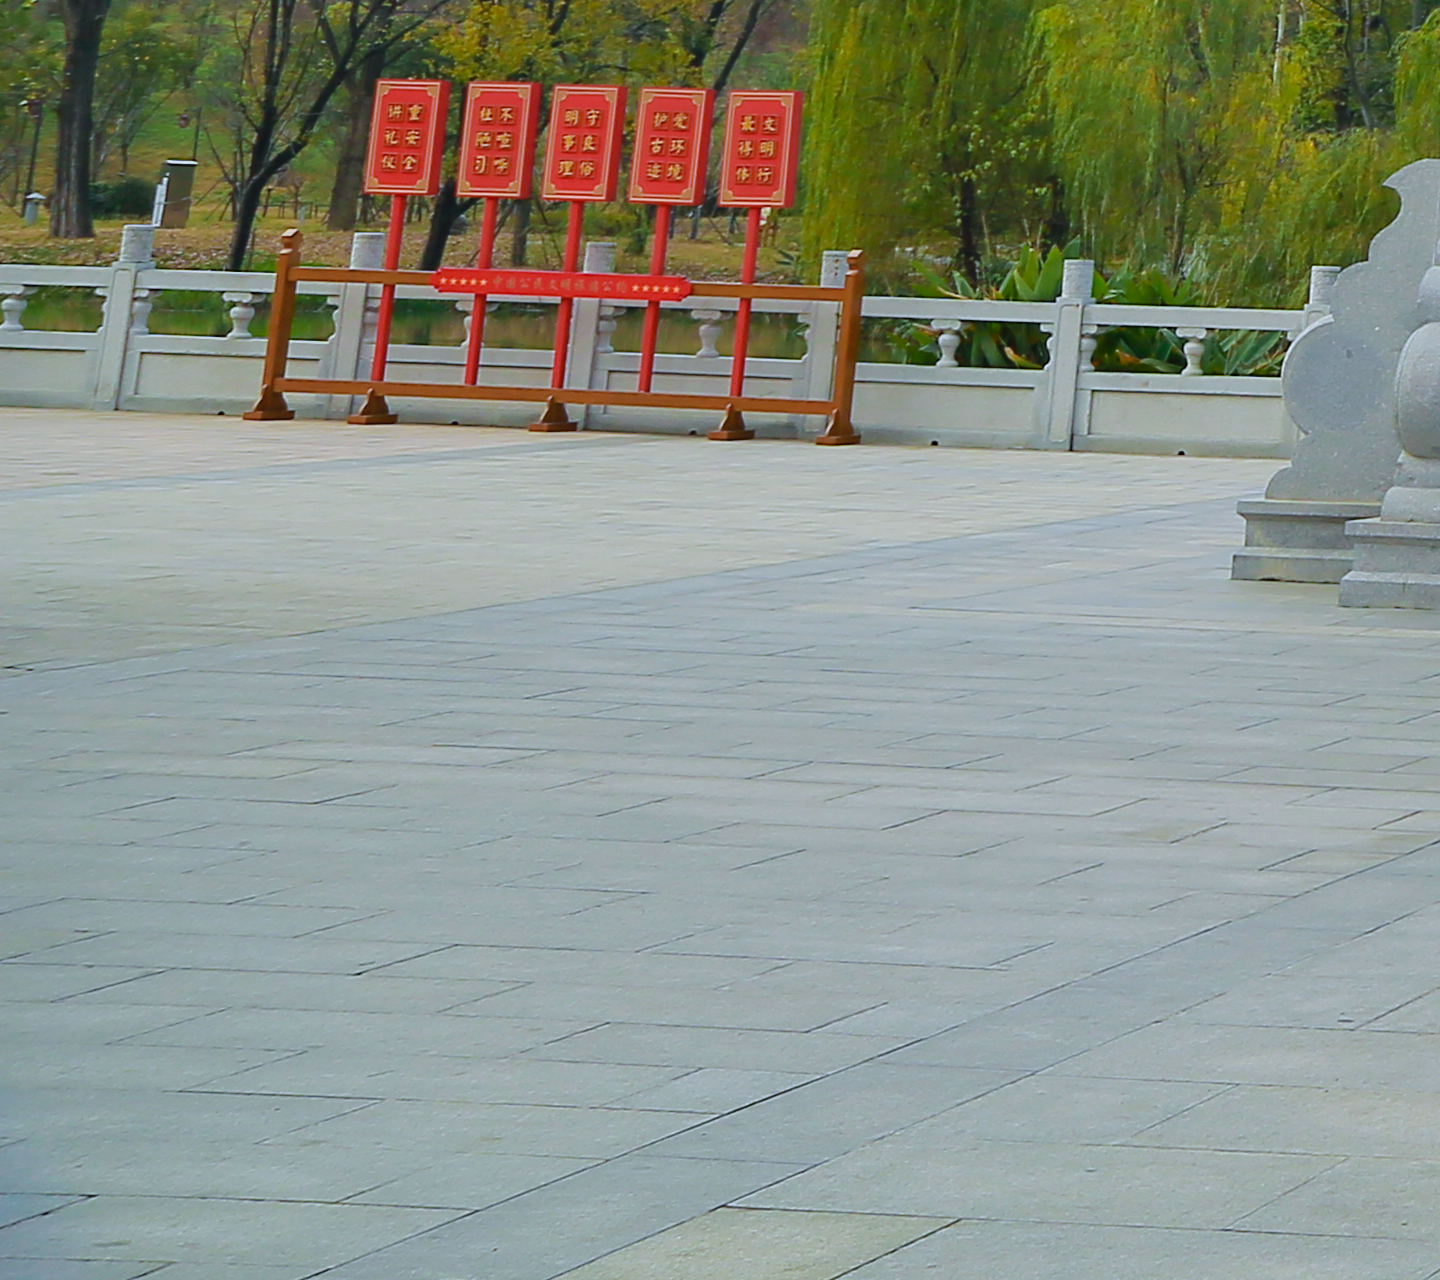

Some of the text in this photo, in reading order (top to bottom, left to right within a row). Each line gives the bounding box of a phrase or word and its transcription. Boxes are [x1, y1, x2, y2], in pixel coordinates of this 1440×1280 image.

[381, 104, 403, 170] 讲礼仪
[402, 104, 423, 170] 重安全
[558, 109, 579, 176] 明事理
[580, 109, 601, 176] 守良俗
[646, 112, 667, 179] 护古迹
[667, 112, 687, 180] 爱环境
[735, 116, 756, 181] 最得体
[756, 117, 777, 182] 文明行
